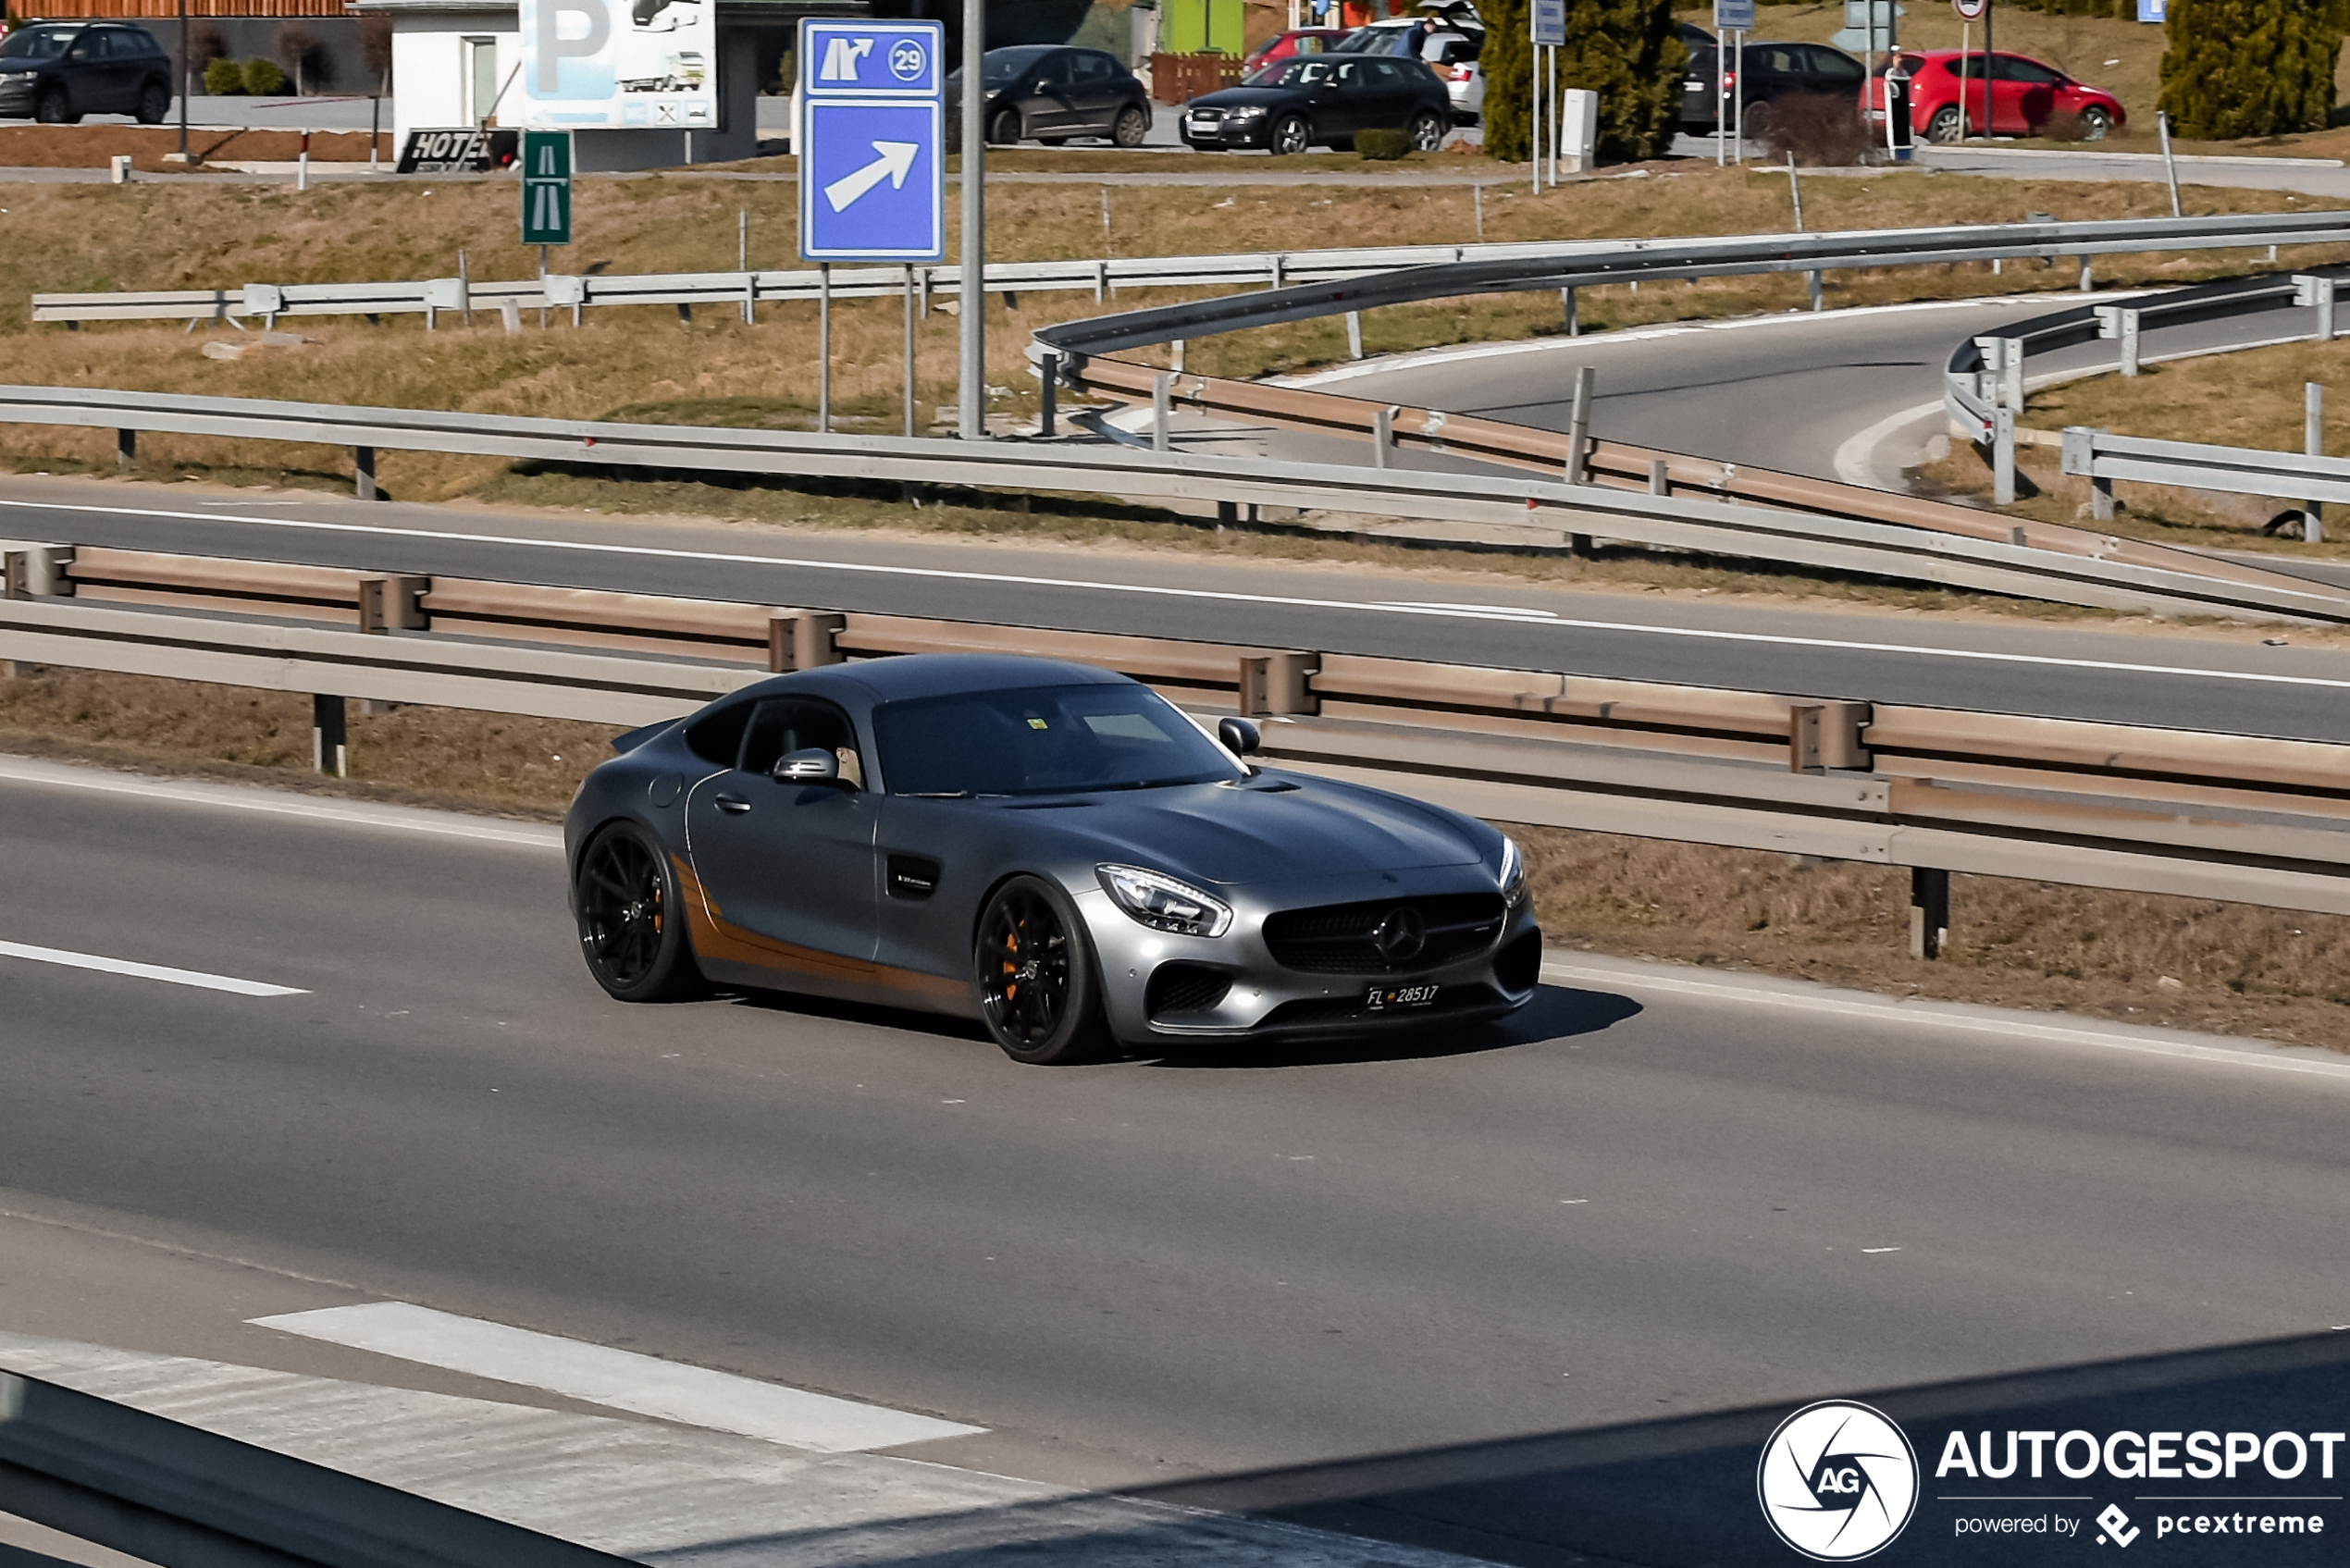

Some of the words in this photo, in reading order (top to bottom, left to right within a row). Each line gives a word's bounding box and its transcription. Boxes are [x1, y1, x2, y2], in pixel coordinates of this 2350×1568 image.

[537, 0, 611, 93] P
[895, 49, 921, 71] 29
[1367, 990, 1383, 1005] FL
[1396, 985, 1440, 1003] 28517
